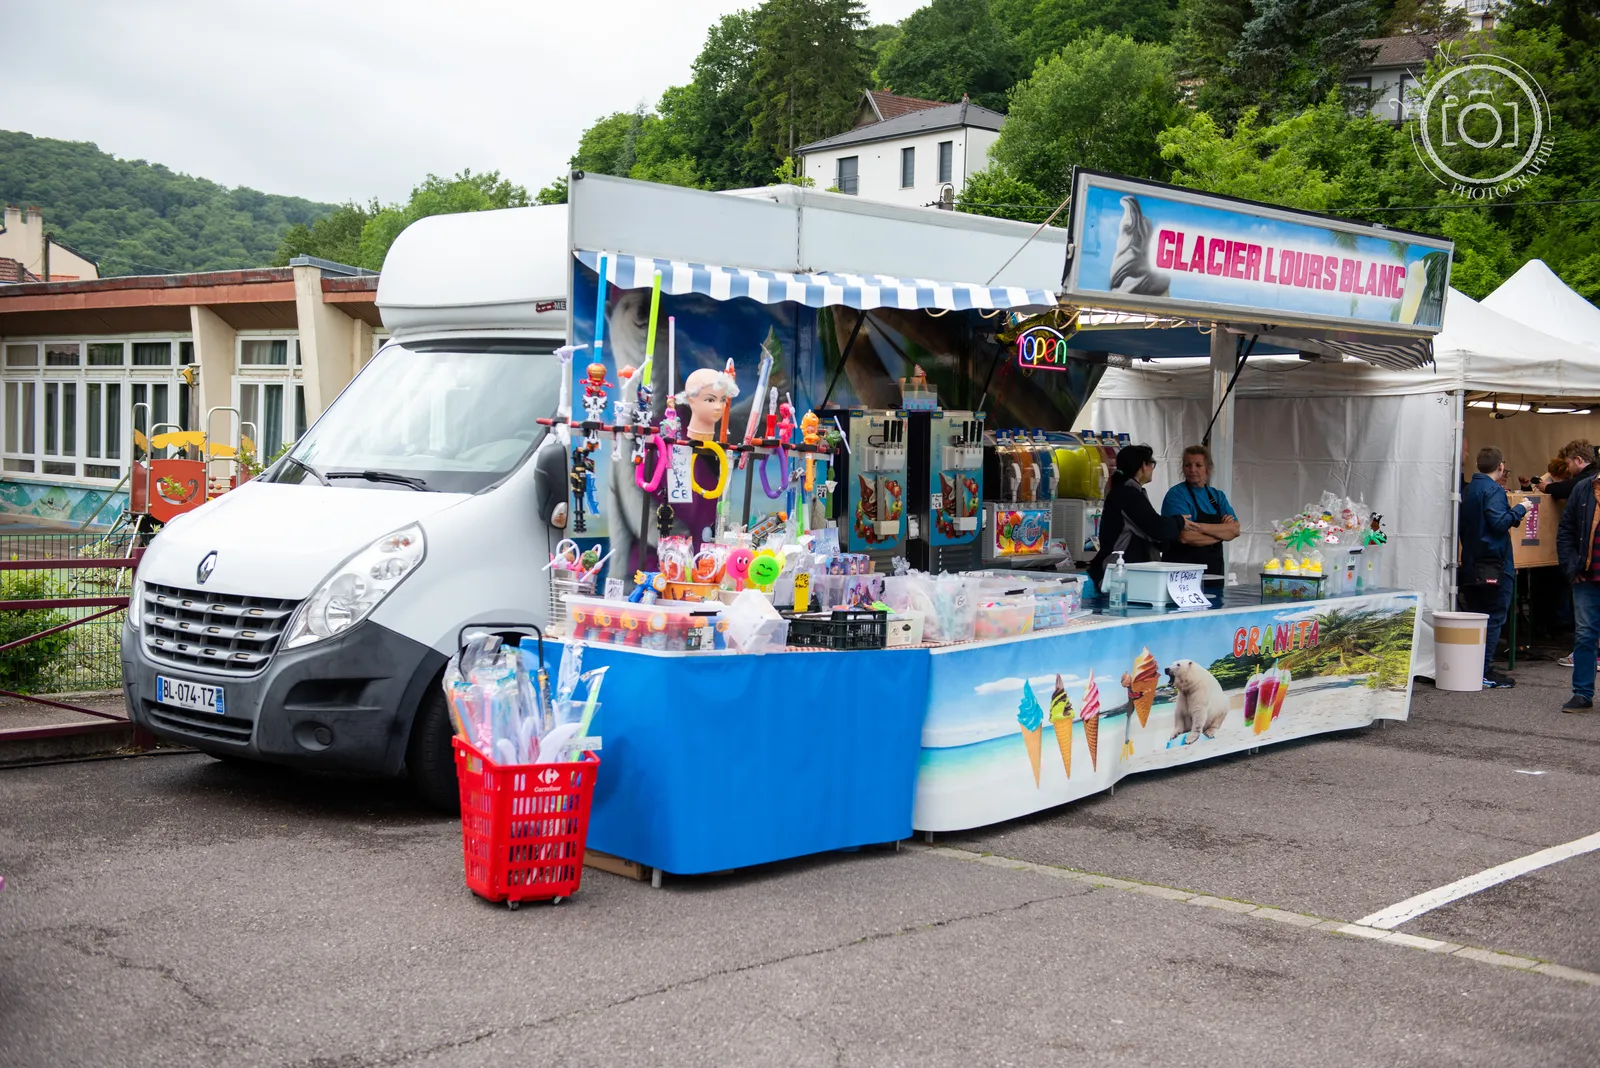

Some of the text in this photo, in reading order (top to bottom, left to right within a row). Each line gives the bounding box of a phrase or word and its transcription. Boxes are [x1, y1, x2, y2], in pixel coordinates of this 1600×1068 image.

[1156, 229, 1263, 282] GLACIER
[1339, 258, 1407, 299] BLANC
[1188, 592, 1205, 604] CB
[1232, 619, 1320, 658] GRANITA
[163, 680, 215, 707] BL-074-TZ
